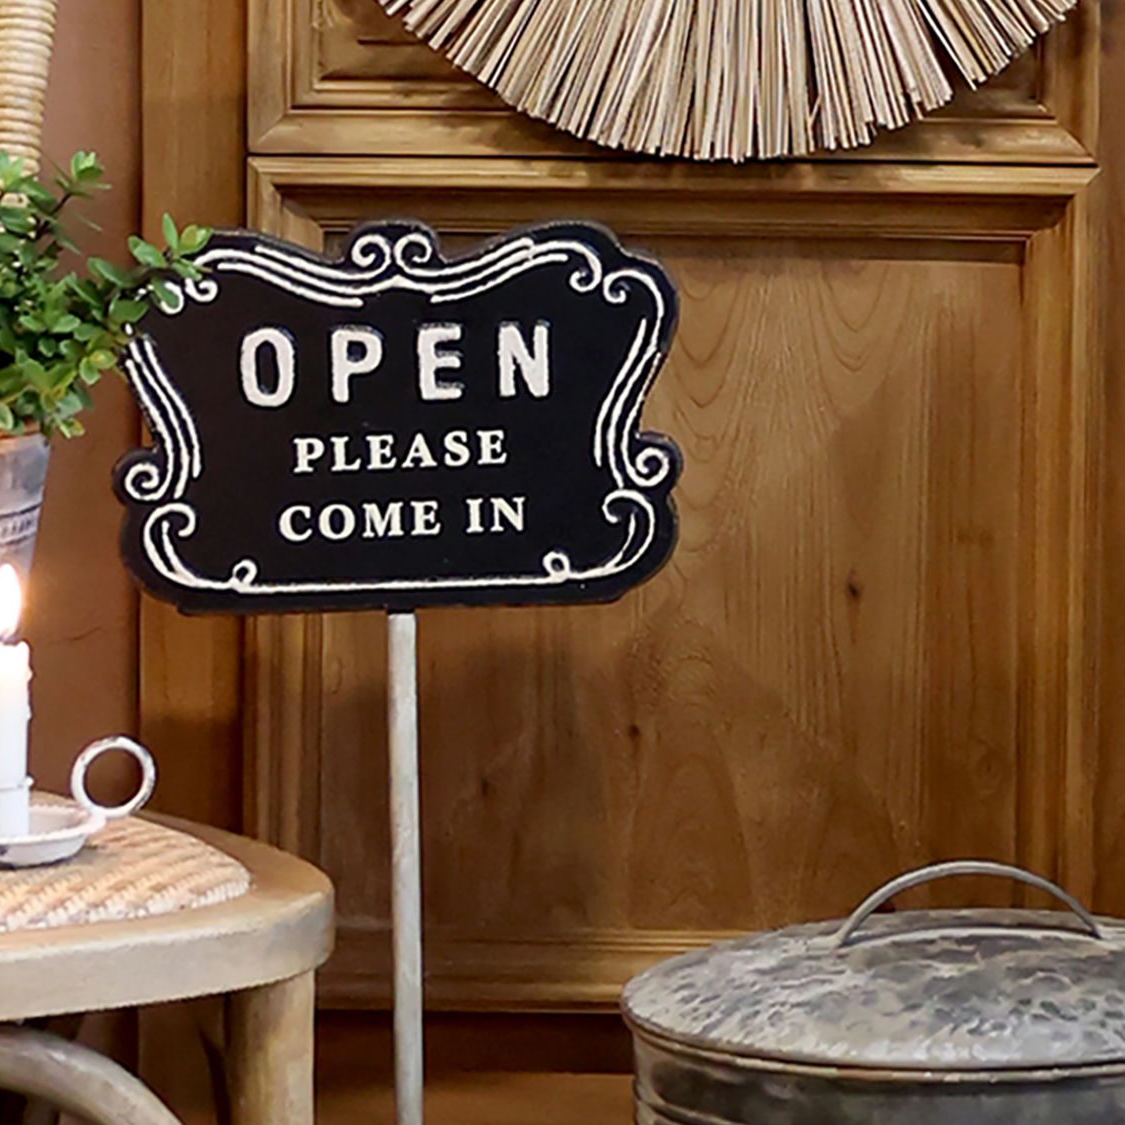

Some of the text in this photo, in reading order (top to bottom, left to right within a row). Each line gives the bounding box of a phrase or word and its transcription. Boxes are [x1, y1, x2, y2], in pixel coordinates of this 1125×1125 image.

[240, 323, 551, 407] OPEN
[293, 429, 508, 474] PLEASE
[279, 496, 526, 542] COME IN
